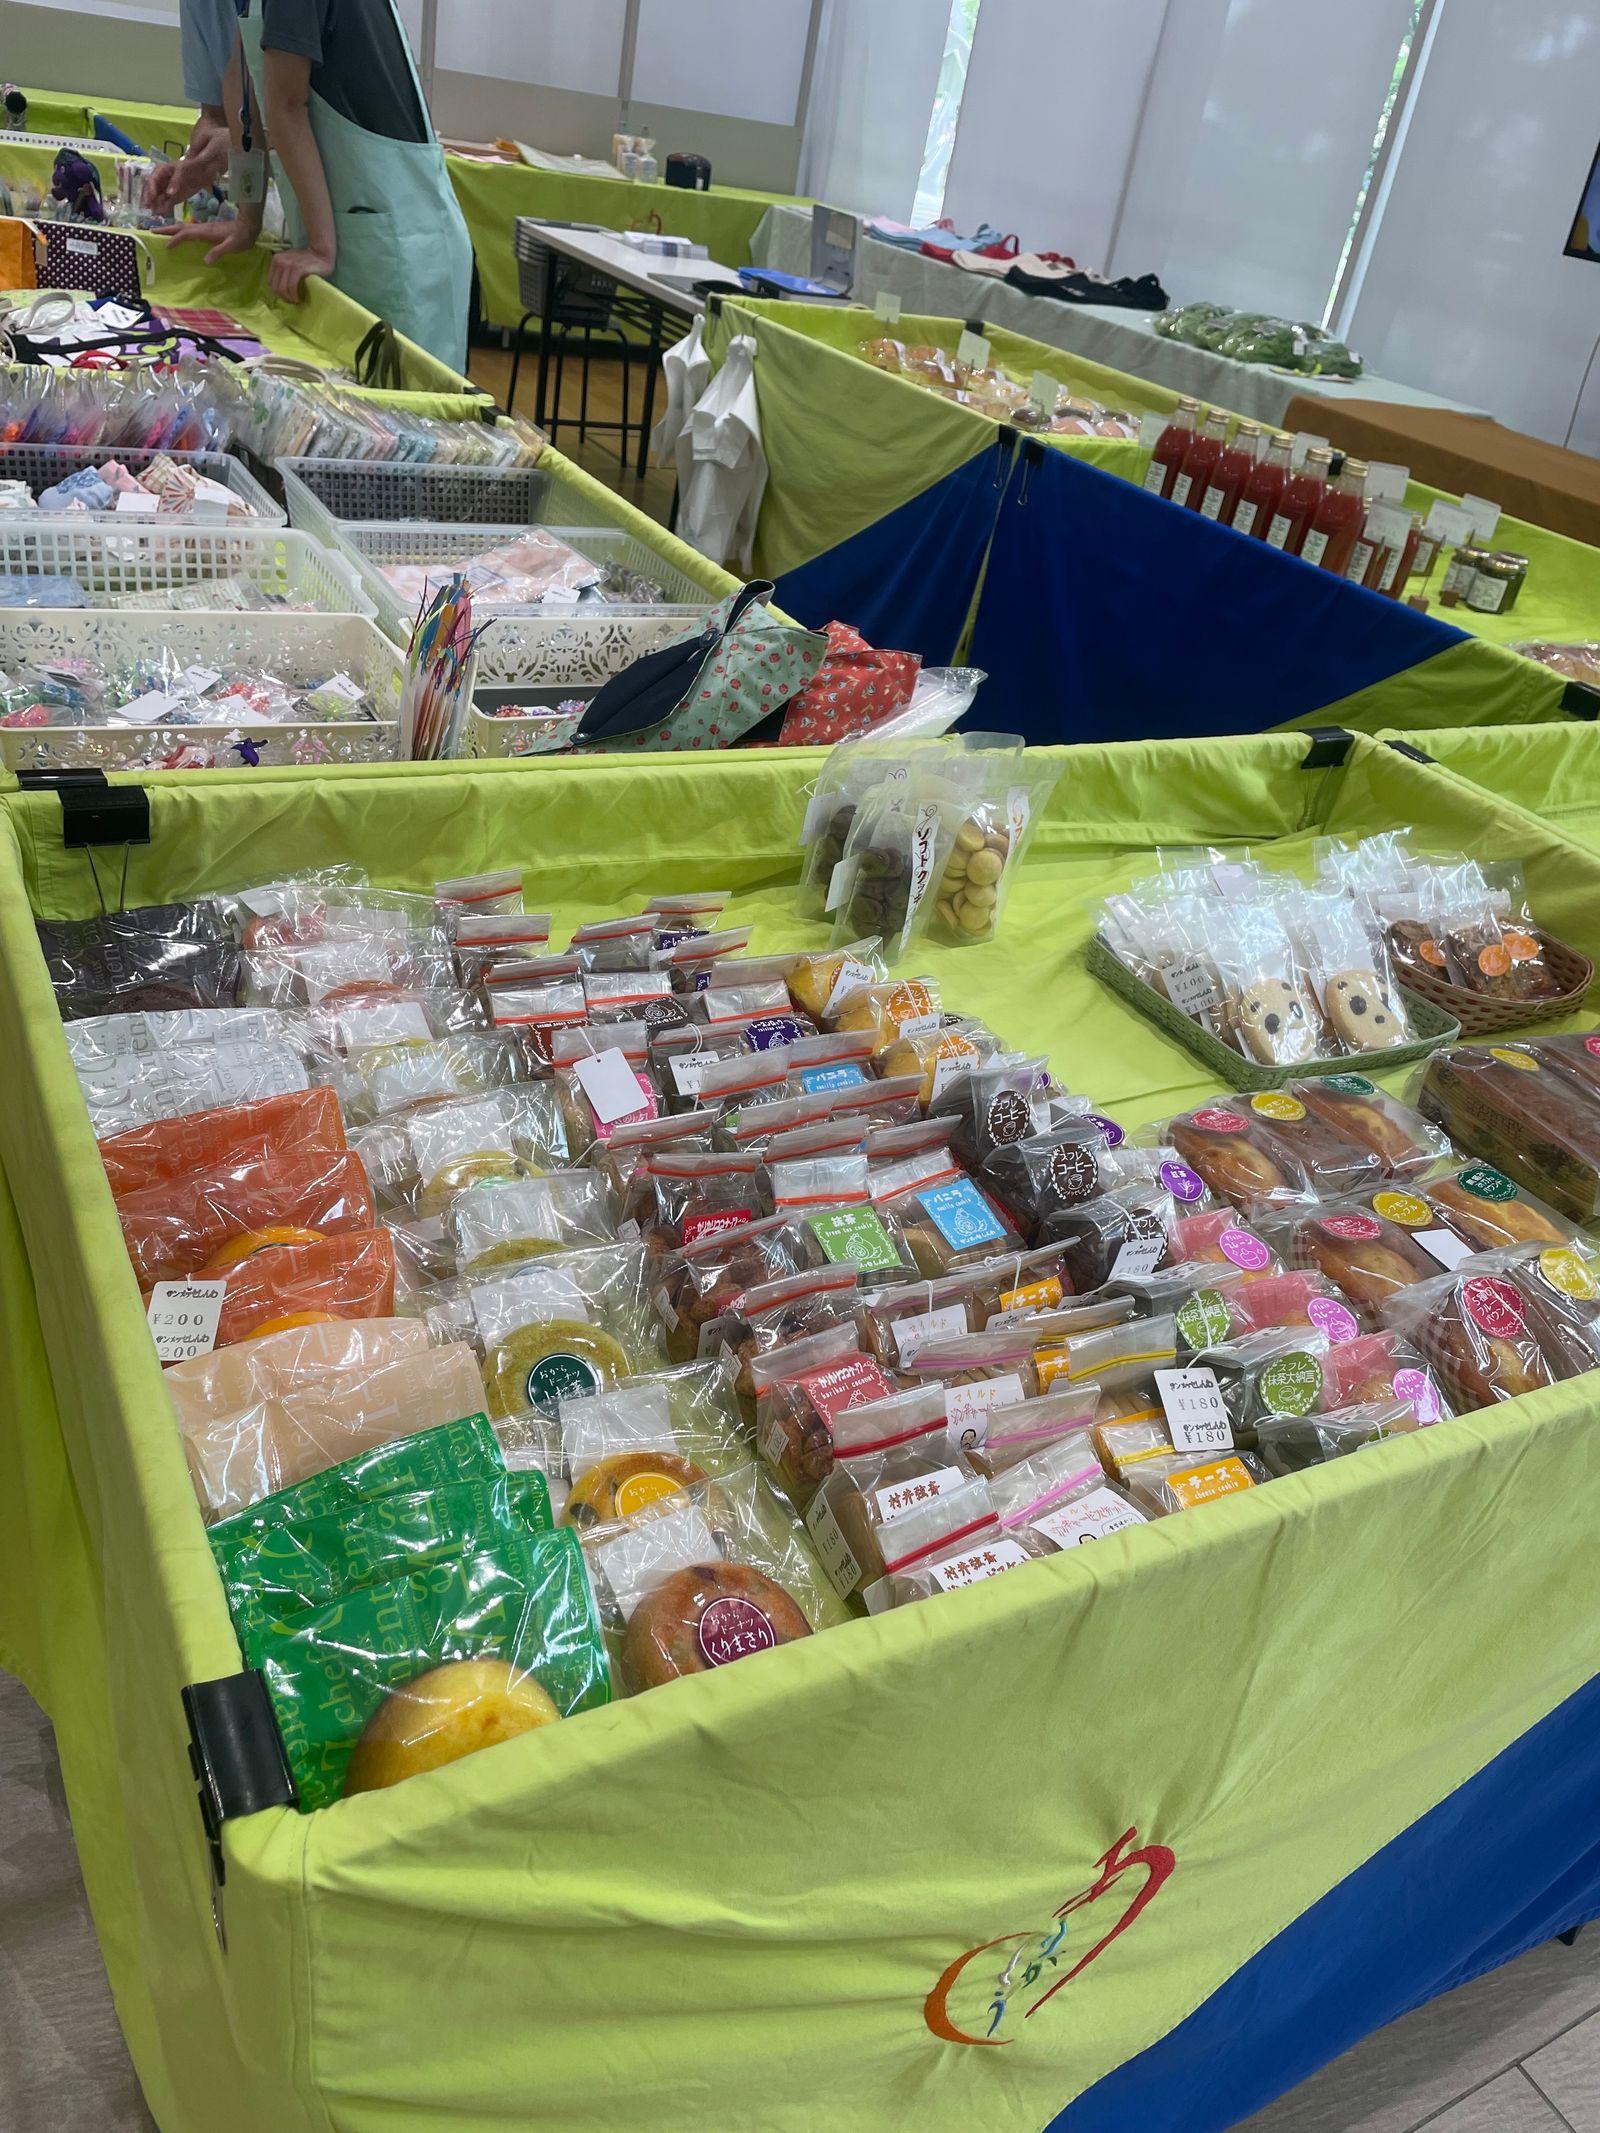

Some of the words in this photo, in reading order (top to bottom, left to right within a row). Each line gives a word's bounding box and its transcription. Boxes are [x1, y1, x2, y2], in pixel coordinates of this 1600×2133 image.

[816, 1069, 847, 1082] バニラ
[997, 1100, 1018, 1111] スフレ
[994, 1109, 1026, 1125] コーヒー
[1060, 1151, 1083, 1161] スフレ
[1057, 1161, 1093, 1176] コーヒー
[1170, 1170, 1187, 1179] 紅茶
[933, 1189, 963, 1203] バニラ
[830, 1213, 858, 1228] 抹茶
[1224, 1239, 1253, 1250] プレーン
[1016, 1287, 1048, 1306] チーズ
[1472, 1287, 1493, 1306] 5種の
[153, 1313, 204, 1326] ¥200
[1313, 1306, 1342, 1319] プレーン
[540, 1364, 567, 1380] おから
[1278, 1361, 1307, 1372] スフレ
[1267, 1369, 1315, 1387] 抹茶大納言
[820, 1382, 850, 1400] karikari
[851, 1373, 875, 1388] coconut
[1178, 1396, 1219, 1411] ¥180
[1184, 1431, 1226, 1444] ¥180
[1188, 1466, 1231, 1489] チーズ
[1218, 1480, 1239, 1493] cookie
[710, 1609, 740, 1626] おから
[721, 1618, 754, 1635] ドーナツ
[712, 1627, 769, 1659] くりまさり
